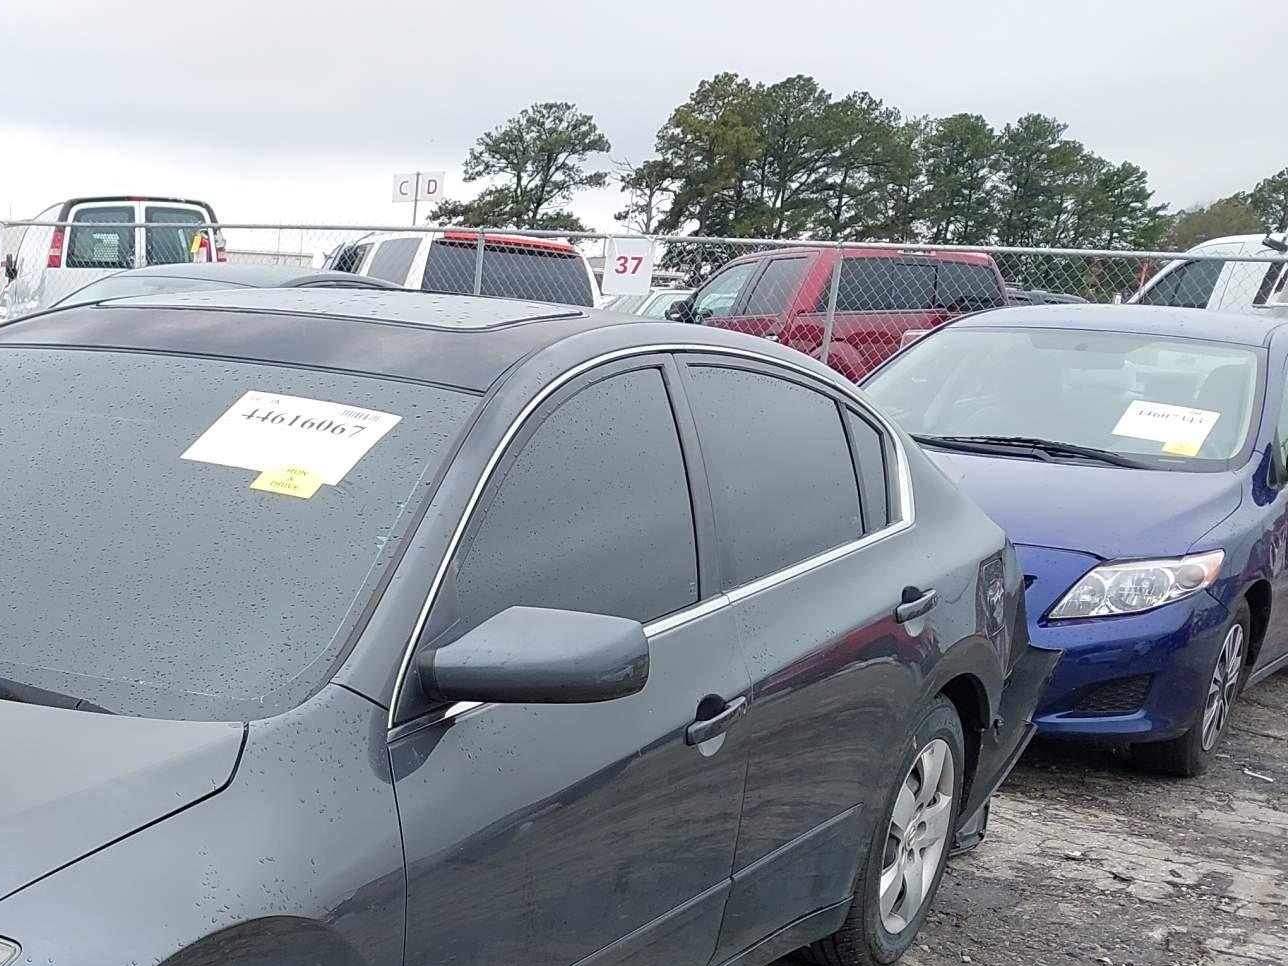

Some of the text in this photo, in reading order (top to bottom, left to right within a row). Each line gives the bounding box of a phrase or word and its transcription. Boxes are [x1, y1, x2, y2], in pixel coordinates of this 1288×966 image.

[398, 180, 409, 196] C
[426, 179, 438, 195] D
[614, 255, 643, 275] 37
[241, 408, 367, 438] 44616067
